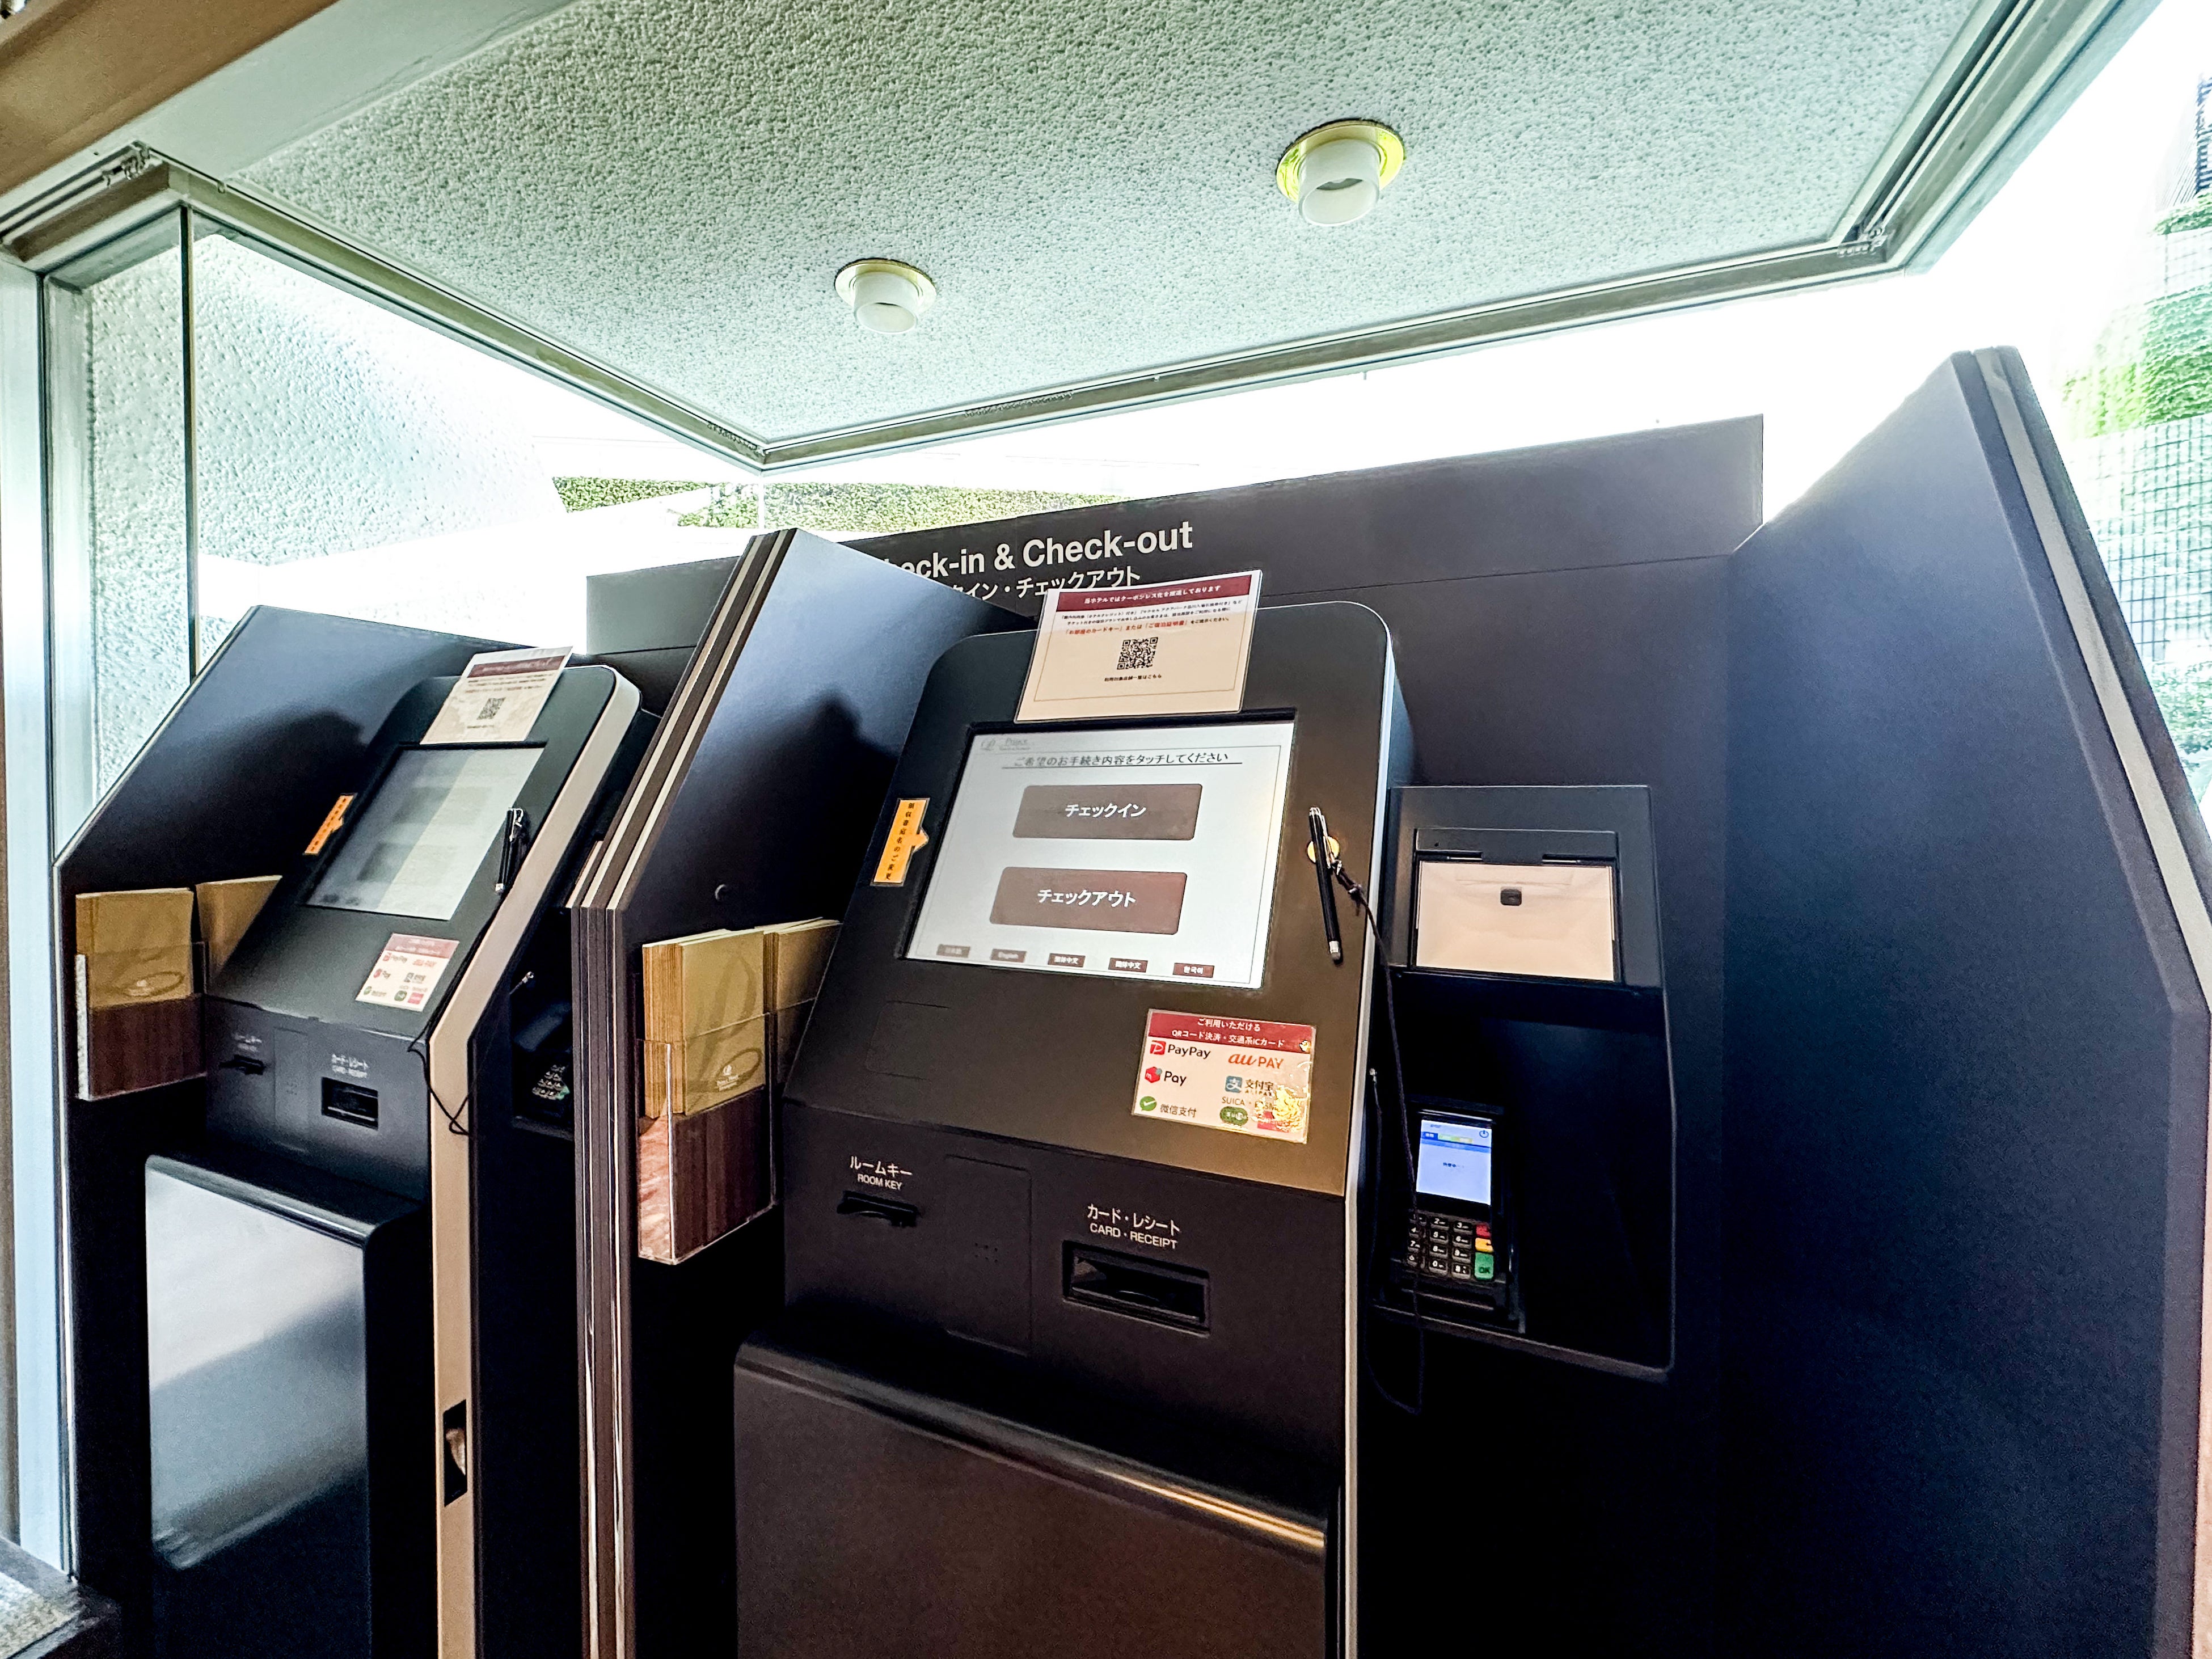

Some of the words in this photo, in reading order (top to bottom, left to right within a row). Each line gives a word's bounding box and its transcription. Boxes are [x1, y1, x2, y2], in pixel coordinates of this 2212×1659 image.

[884, 548, 985, 578] ck-in
[994, 543, 1015, 571] &
[1023, 521, 1193, 567] Check-out
[952, 565, 1141, 601] イン・チェックアウト
[1015, 752, 1228, 766] ご希望のお手続き内容をタッチしてください
[1065, 803, 1146, 818] チェックイン
[1037, 889, 1136, 907] チェックアウト
[1197, 1018, 1261, 1032] ご利用いただける
[1167, 1044, 1211, 1059] PayPay
[1227, 1053, 1257, 1065] au
[1258, 1056, 1284, 1069] PAY
[1163, 1070, 1187, 1086] Pay
[1245, 1078, 1274, 1092] 支付宝
[1222, 1096, 1246, 1106] SUICA
[1160, 1103, 1197, 1118] 微信支付
[850, 1155, 913, 1178] ルームキー
[857, 1173, 884, 1187] ROOM
[885, 1179, 903, 1191] KEY
[1087, 1203, 1181, 1236] カード・レシート
